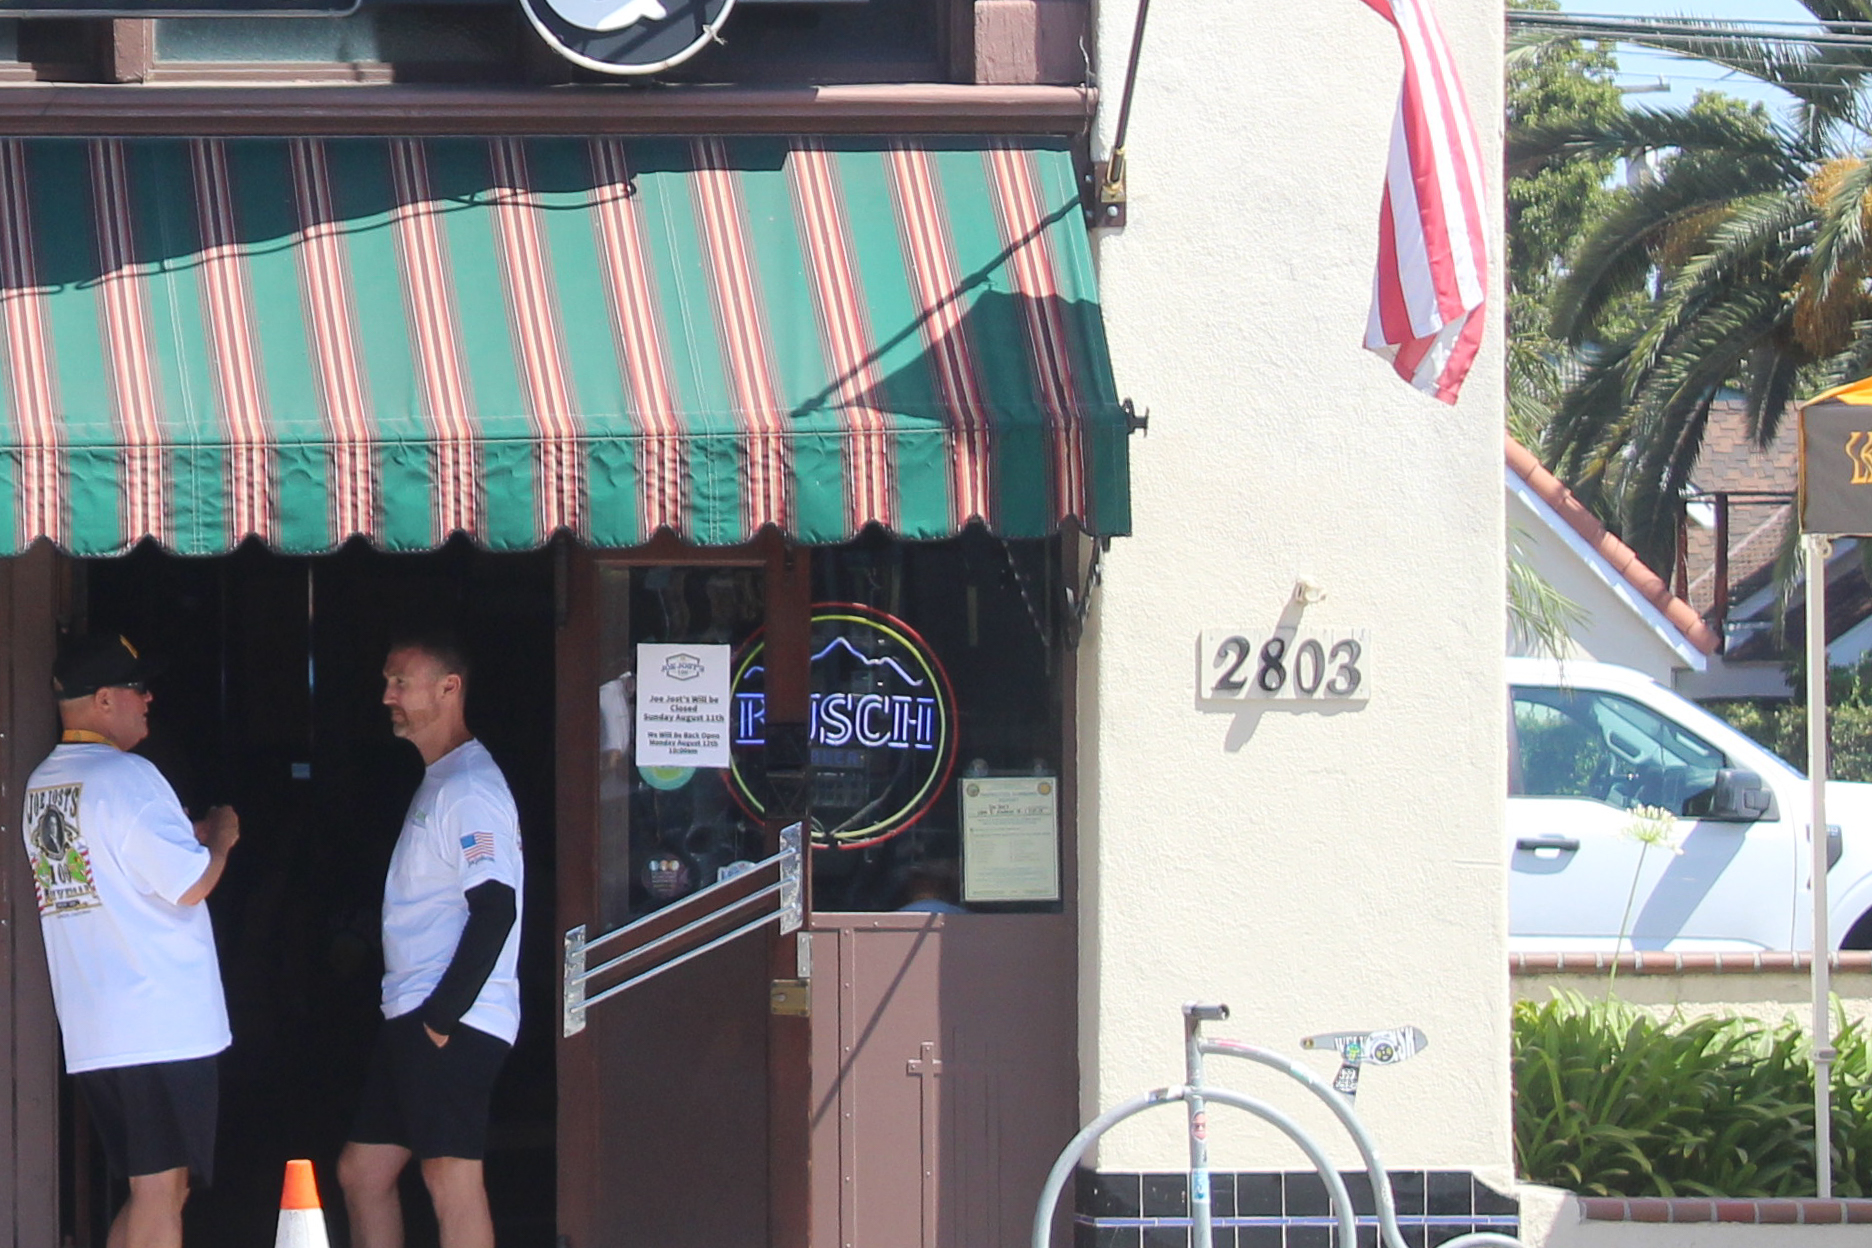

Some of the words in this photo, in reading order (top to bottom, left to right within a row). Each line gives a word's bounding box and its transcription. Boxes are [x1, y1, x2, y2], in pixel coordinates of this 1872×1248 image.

[1212, 636, 1362, 697] 2803
[649, 695, 664, 704] Joe
[666, 695, 690, 704] Jost's
[691, 695, 707, 704] Will
[709, 695, 719, 704] be
[670, 704, 698, 713] Closed
[643, 713, 674, 723] Sunday
[675, 714, 704, 723] August
[706, 714, 725, 722] 11th
[27, 792, 45, 824] JOE
